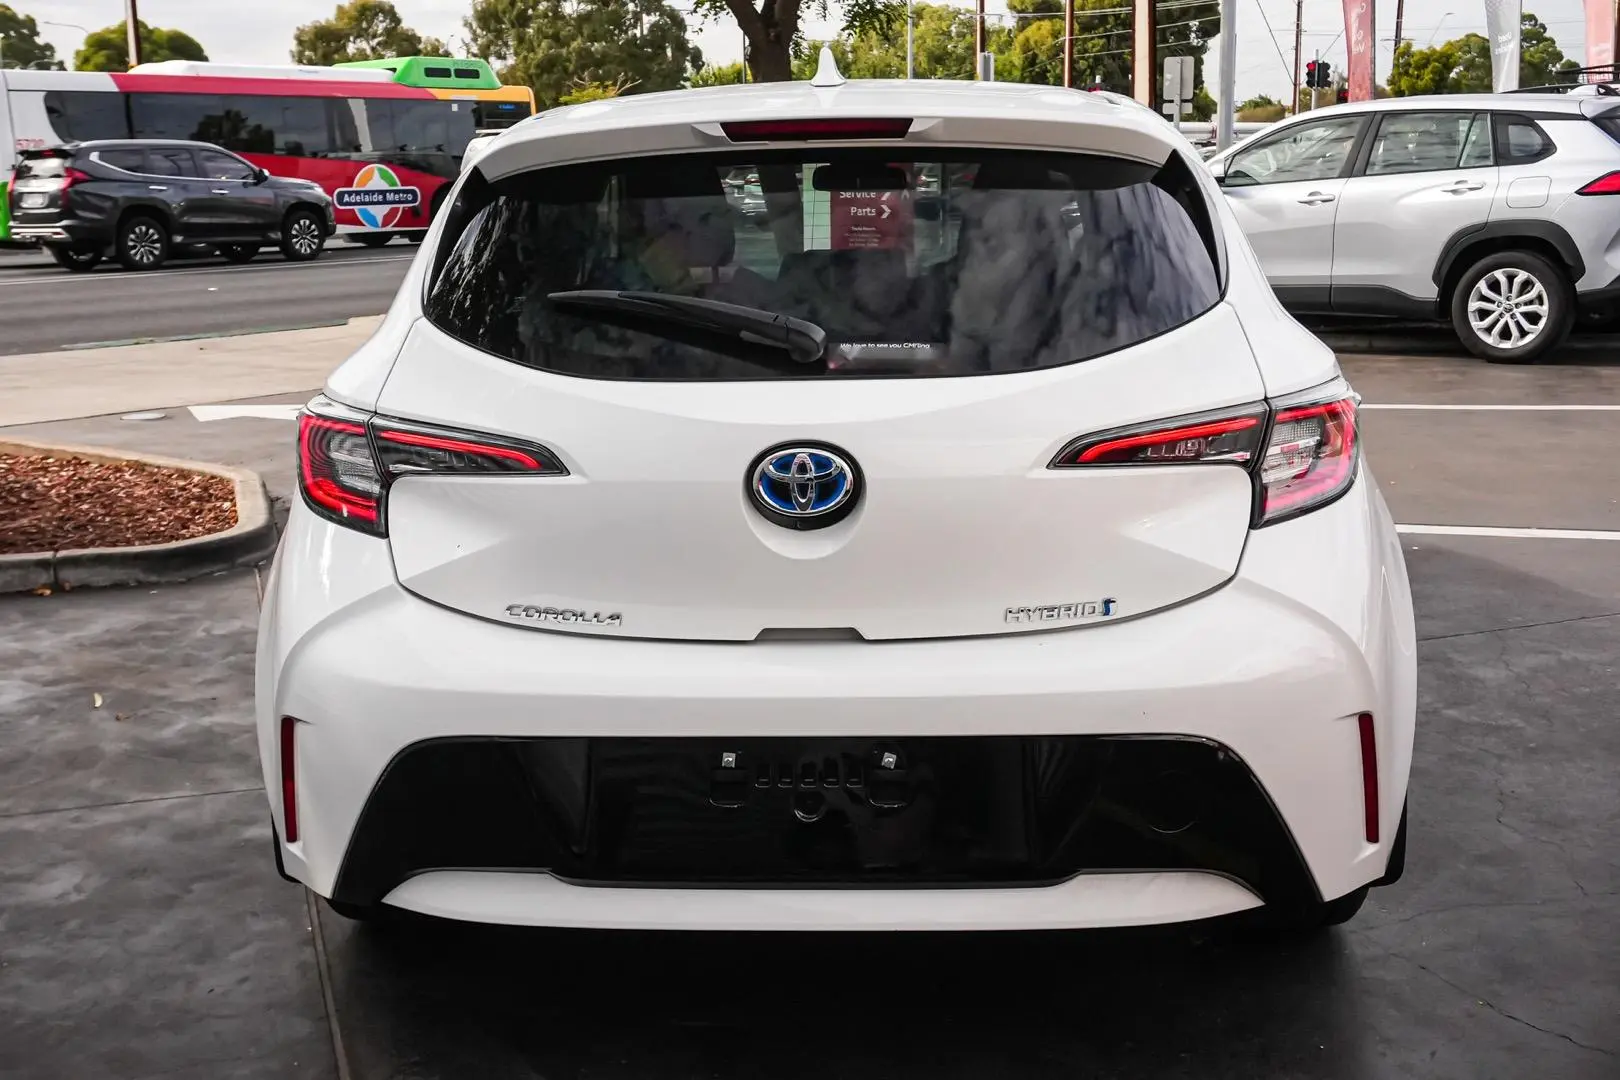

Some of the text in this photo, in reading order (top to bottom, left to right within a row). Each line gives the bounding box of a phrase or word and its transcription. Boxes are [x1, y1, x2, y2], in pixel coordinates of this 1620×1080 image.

[343, 191, 413, 203] Adelaide Metro
[850, 206, 877, 216] Parts
[505, 603, 622, 627] COROLLA
[1005, 601, 1098, 624] HYBRID
